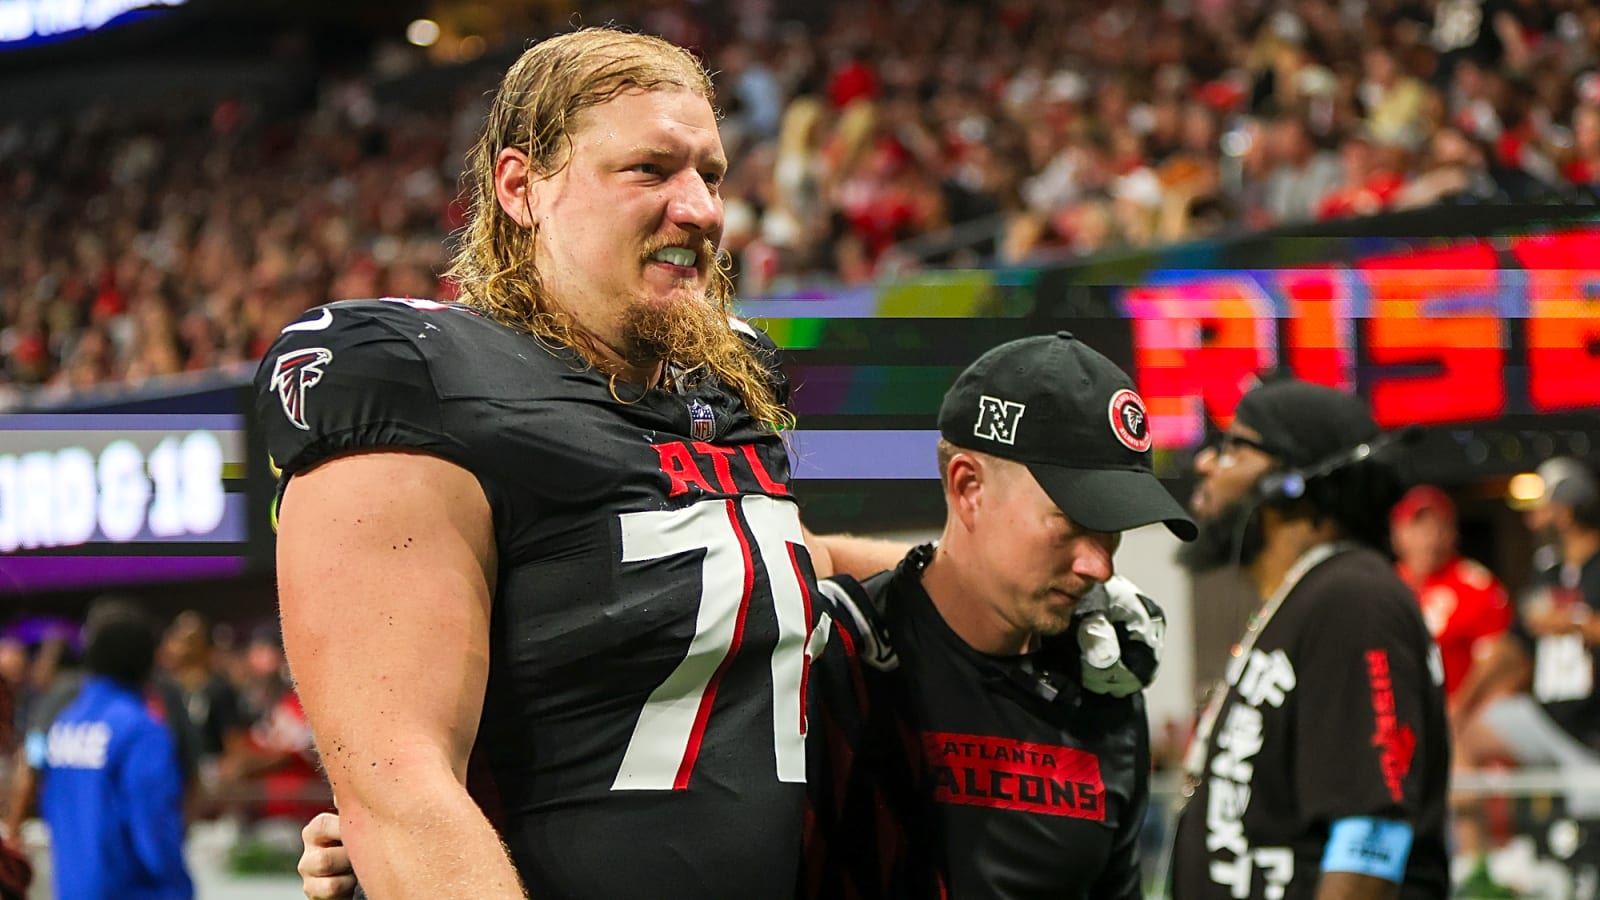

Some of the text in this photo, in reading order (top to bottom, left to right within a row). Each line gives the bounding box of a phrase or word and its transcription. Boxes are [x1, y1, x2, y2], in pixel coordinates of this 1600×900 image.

[1122, 226, 1600, 449] RISE
[650, 442, 790, 497] ATL
[943, 741, 1057, 769] ATLANTA
[932, 765, 1099, 812] ALCONS
